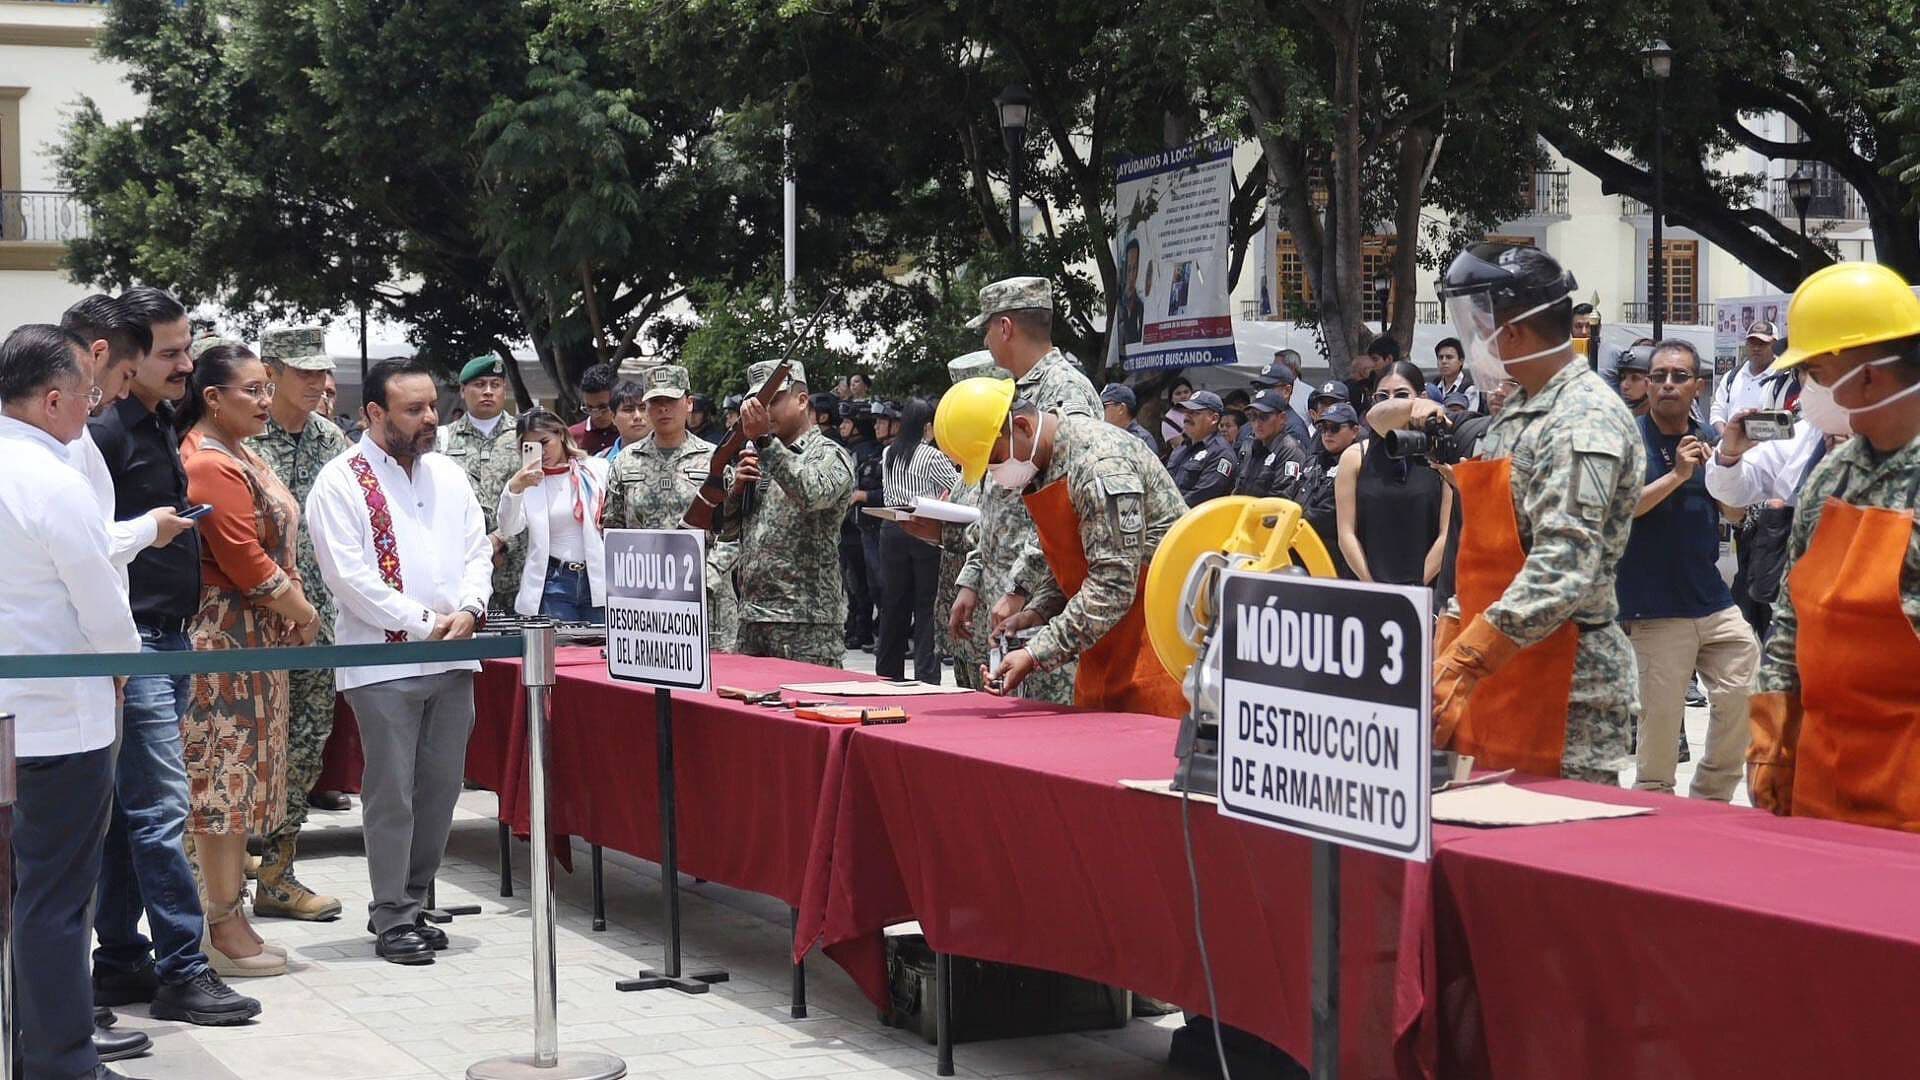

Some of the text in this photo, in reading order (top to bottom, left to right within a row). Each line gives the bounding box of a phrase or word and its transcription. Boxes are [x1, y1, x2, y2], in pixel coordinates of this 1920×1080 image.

[1162, 152, 1169, 166] A
[1135, 354, 1164, 369] SEGUIMOS
[1165, 350, 1223, 367] BUSCANDO...
[613, 545, 695, 592] MÓDULO 2
[610, 607, 699, 637] DESORGANIZACIÓN
[1236, 595, 1404, 685] MÓDULO 3
[617, 637, 693, 672] DEL ARMAMENTO
[1239, 700, 1399, 770] DESTRUCCIÓN
[1232, 756, 1406, 829] DE ARMAMENTO
